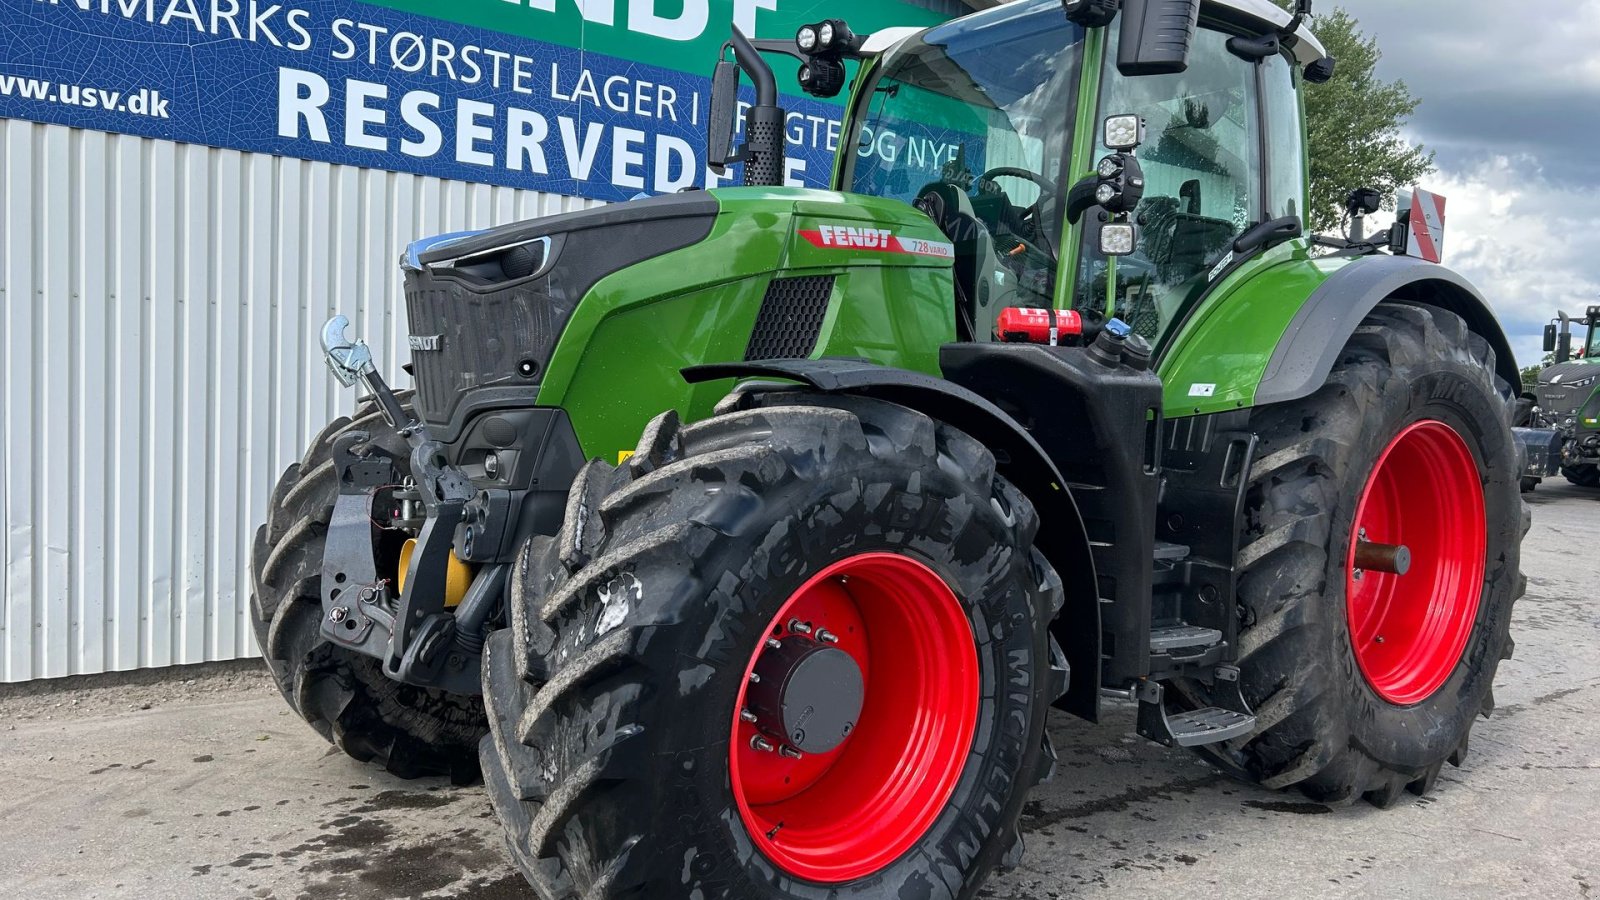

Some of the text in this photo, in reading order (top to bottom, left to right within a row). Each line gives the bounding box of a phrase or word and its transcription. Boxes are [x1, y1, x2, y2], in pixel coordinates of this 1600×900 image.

[332, 19, 534, 94] STØRSTE
[551, 62, 676, 121] LAGER
[692, 91, 698, 126] I
[818, 225, 892, 249] FENDT
[913, 241, 947, 255] 728 VARIO
